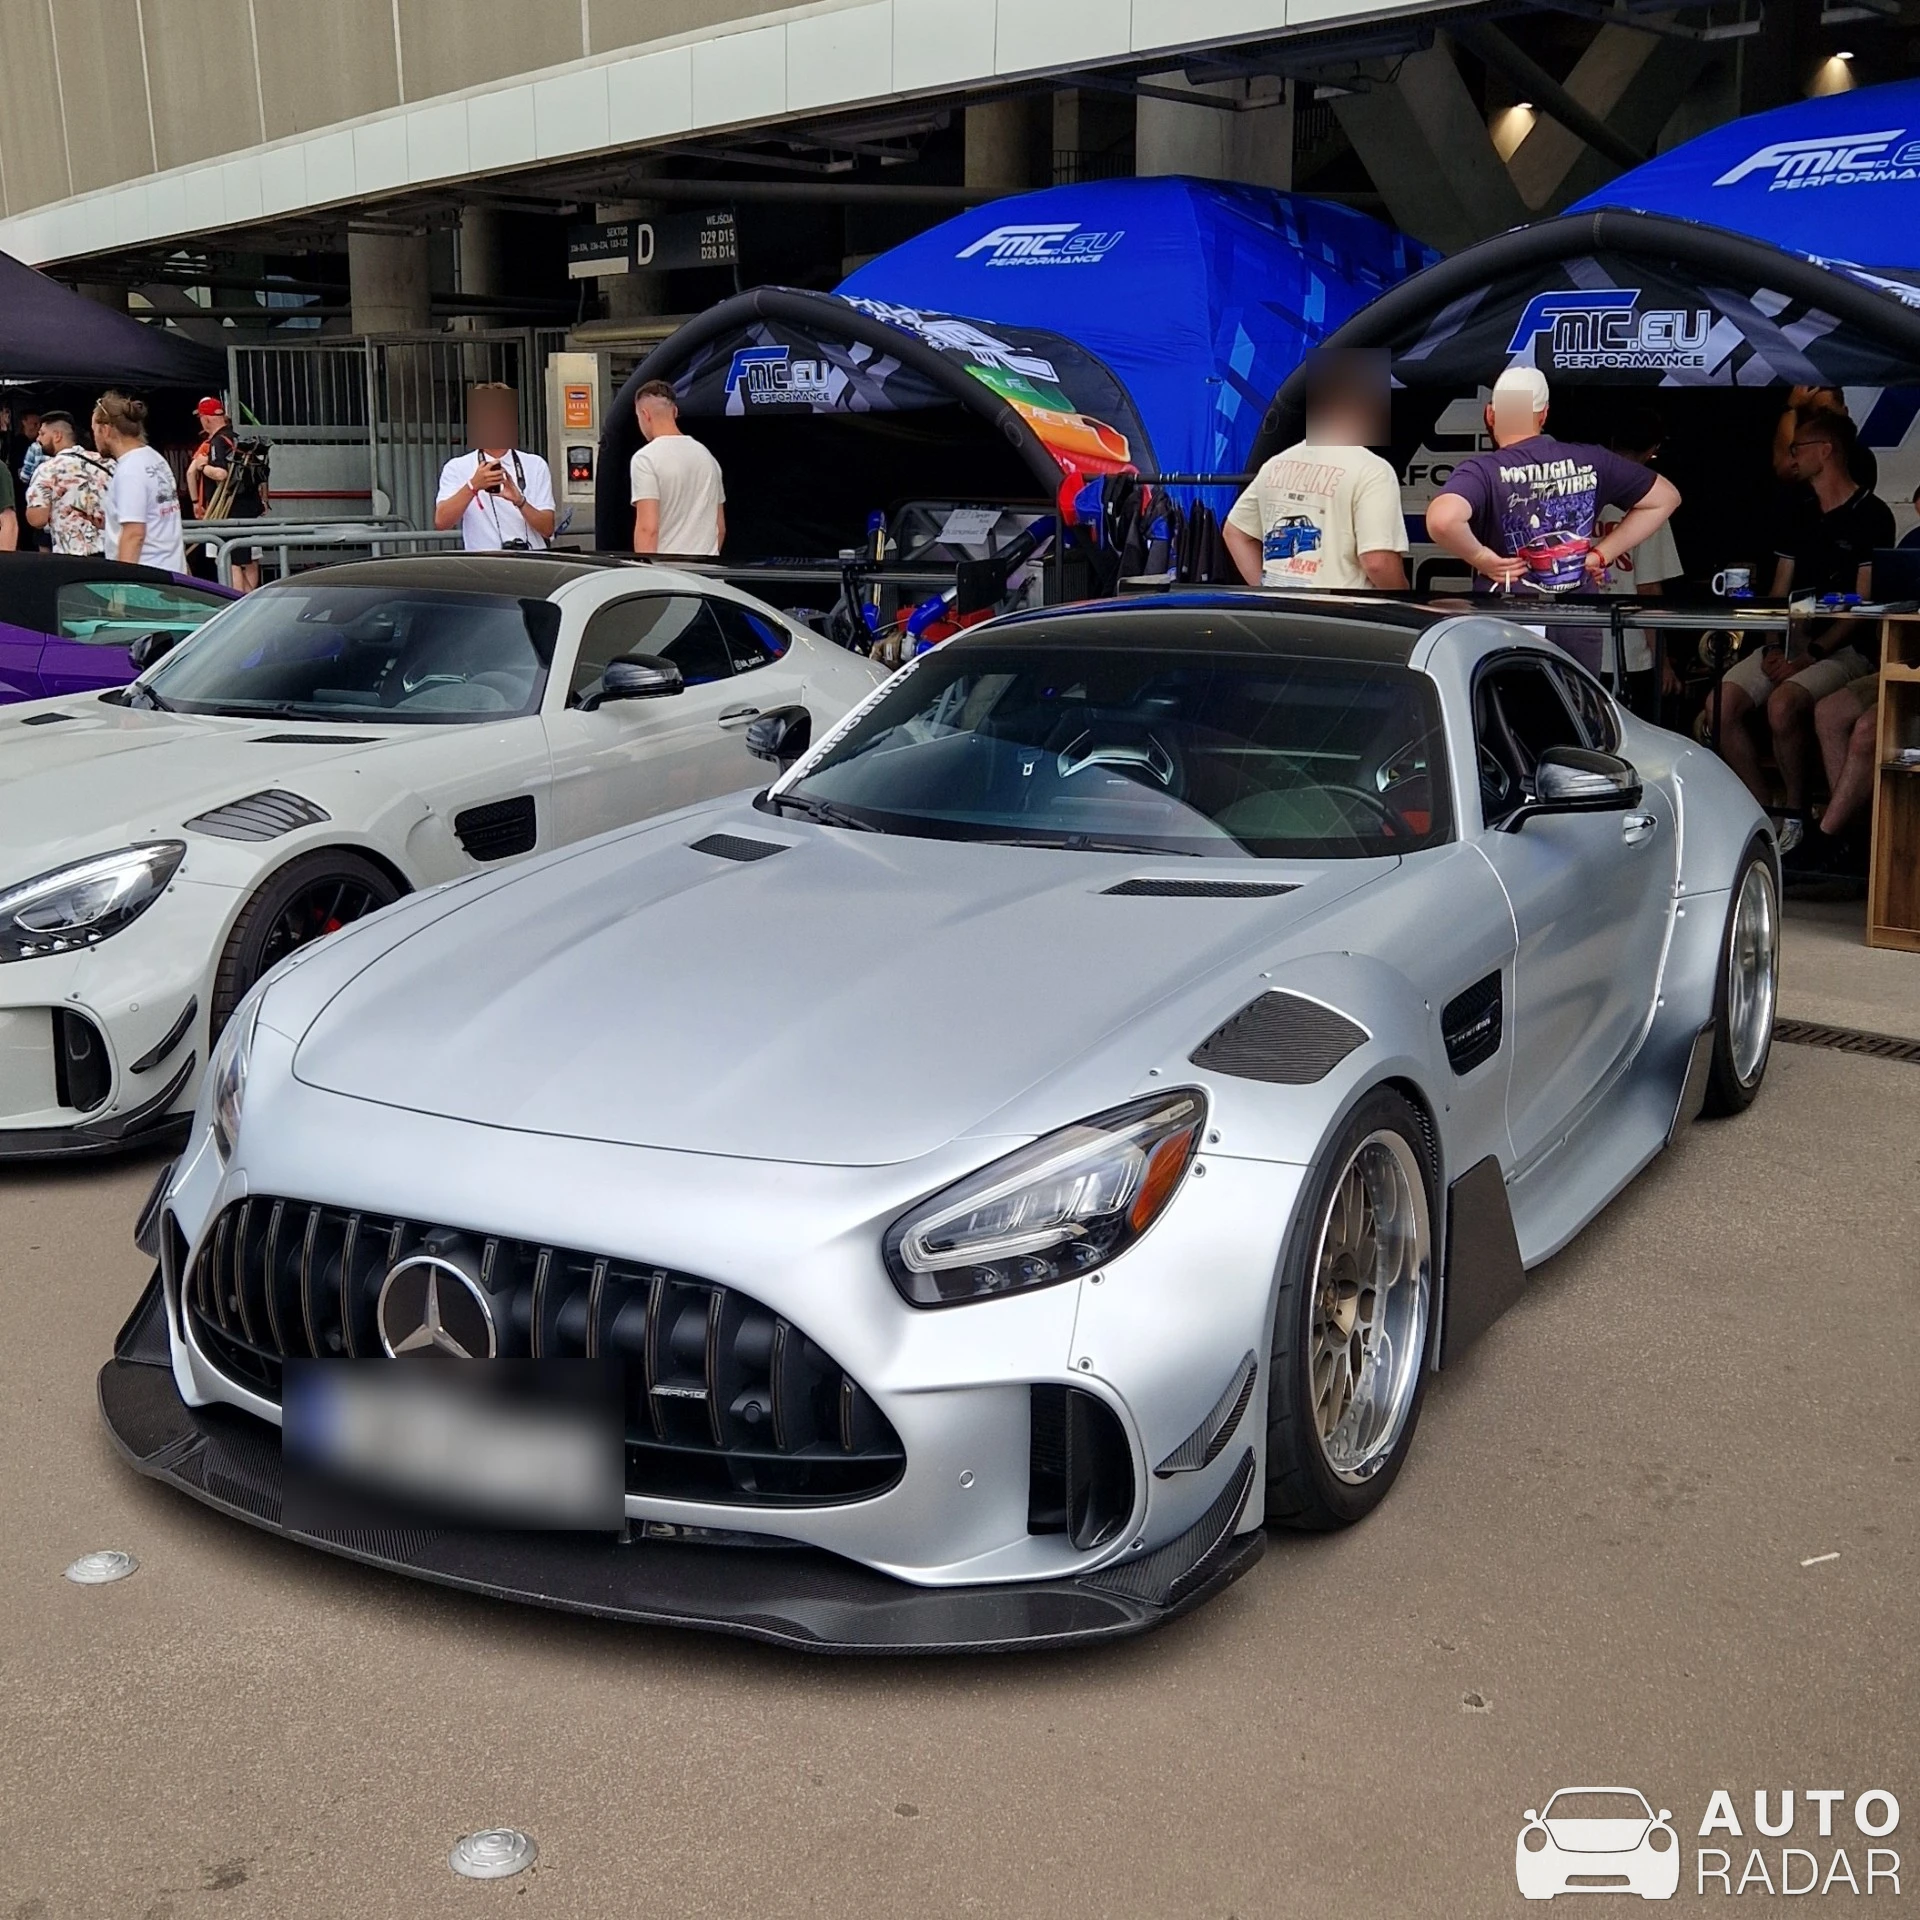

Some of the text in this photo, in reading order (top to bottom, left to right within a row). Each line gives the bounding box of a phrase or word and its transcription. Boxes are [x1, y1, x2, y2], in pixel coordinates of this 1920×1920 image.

[1768, 168, 1920, 192] PERFORMA
[637, 223, 654, 265] D
[700, 229, 735, 244] D29 D15
[955, 223, 1126, 258] FMIC.EU
[701, 244, 736, 260] D28 D14
[985, 254, 1103, 267] PERFORMANCE
[1506, 289, 1710, 353] FMIC.EU
[725, 345, 830, 393] FMIC.EU
[1552, 352, 1707, 369] PERFORMANCE
[751, 391, 831, 404] PERFORMANCE
[1265, 459, 1346, 498] SKYLINE
[1499, 458, 1577, 484] NOSTALGIA
[1555, 471, 1598, 497] VIBES
